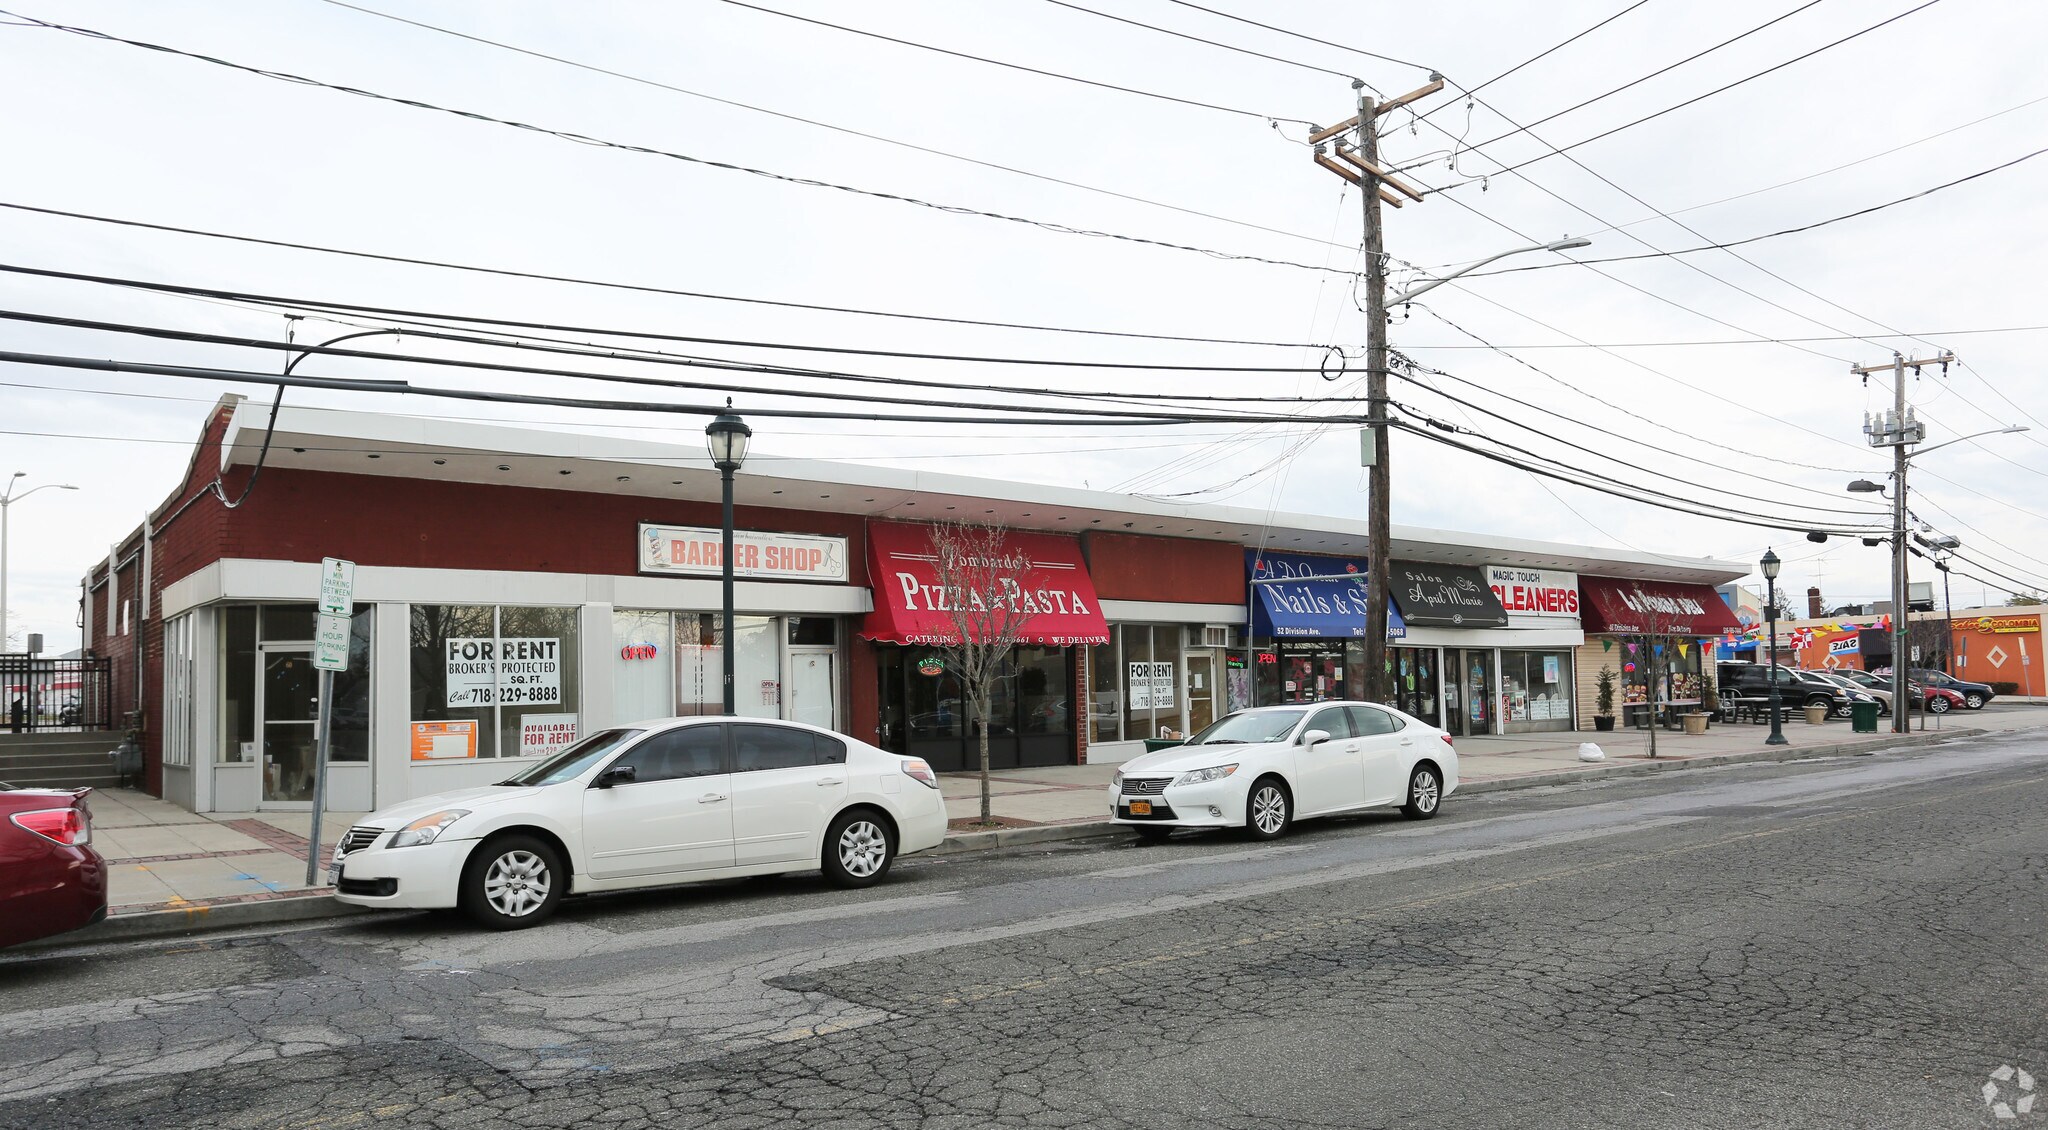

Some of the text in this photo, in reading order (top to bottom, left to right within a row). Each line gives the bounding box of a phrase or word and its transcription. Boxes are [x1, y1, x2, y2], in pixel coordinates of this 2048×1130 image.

[671, 539, 822, 572] BARER SHOP
[1405, 571, 1442, 583] Salon
[1493, 570, 1540, 582] MAGIC TOUCH
[325, 578, 350, 589] PARKING
[323, 587, 350, 596] BETWEEN
[896, 572, 987, 613] PIZZA
[999, 577, 1090, 615] PASTA
[1409, 583, 1446, 607] April
[1440, 585, 1483, 606] Marie
[328, 595, 345, 604] SIGNS
[1264, 584, 1331, 614] Nails
[1333, 594, 1351, 614] &
[1991, 619, 2039, 628] COLOMBIA
[323, 632, 343, 640] HOUR
[1285, 627, 1308, 635] Division
[906, 635, 957, 644] CATERING
[1052, 636, 1066, 644] WE
[1068, 636, 1107, 644] DELIVER
[318, 642, 346, 652] PARKING
[449, 641, 556, 660] FOR RENT
[621, 645, 656, 660] OPEN
[1258, 653, 1277, 663] OPEN
[449, 662, 556, 674] BROKER'S PROTECTED
[1131, 664, 1149, 677] FOR
[511, 675, 542, 684] SQ. FT.
[449, 686, 558, 703] Call 718-229-8888
[525, 723, 576, 732] AVAILABLE
[524, 732, 575, 745] FOR RENT
